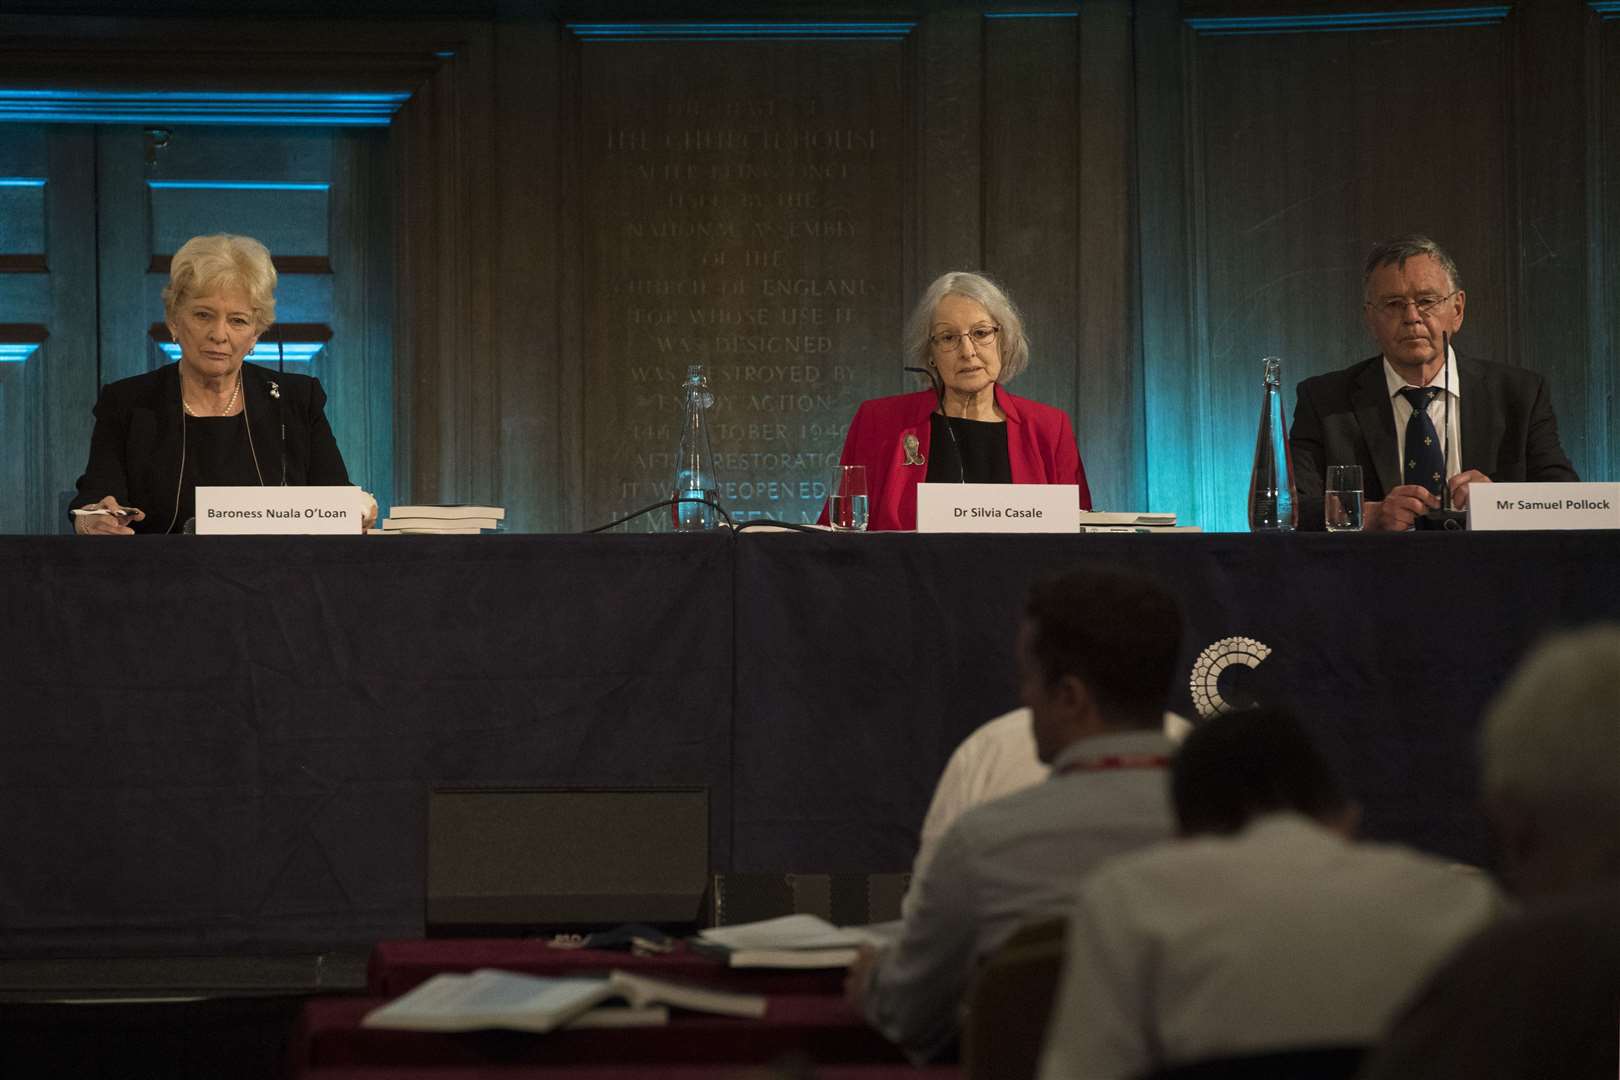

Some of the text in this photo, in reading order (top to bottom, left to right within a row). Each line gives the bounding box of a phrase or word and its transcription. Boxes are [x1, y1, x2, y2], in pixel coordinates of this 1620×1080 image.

[706, 365, 821, 384] ESTROYED
[1496, 499, 1611, 510] Mr Samuel Pollock
[207, 508, 263, 519] Baroness
[266, 508, 301, 519] Nuala
[953, 506, 1043, 519] Dr Silvia Casale
